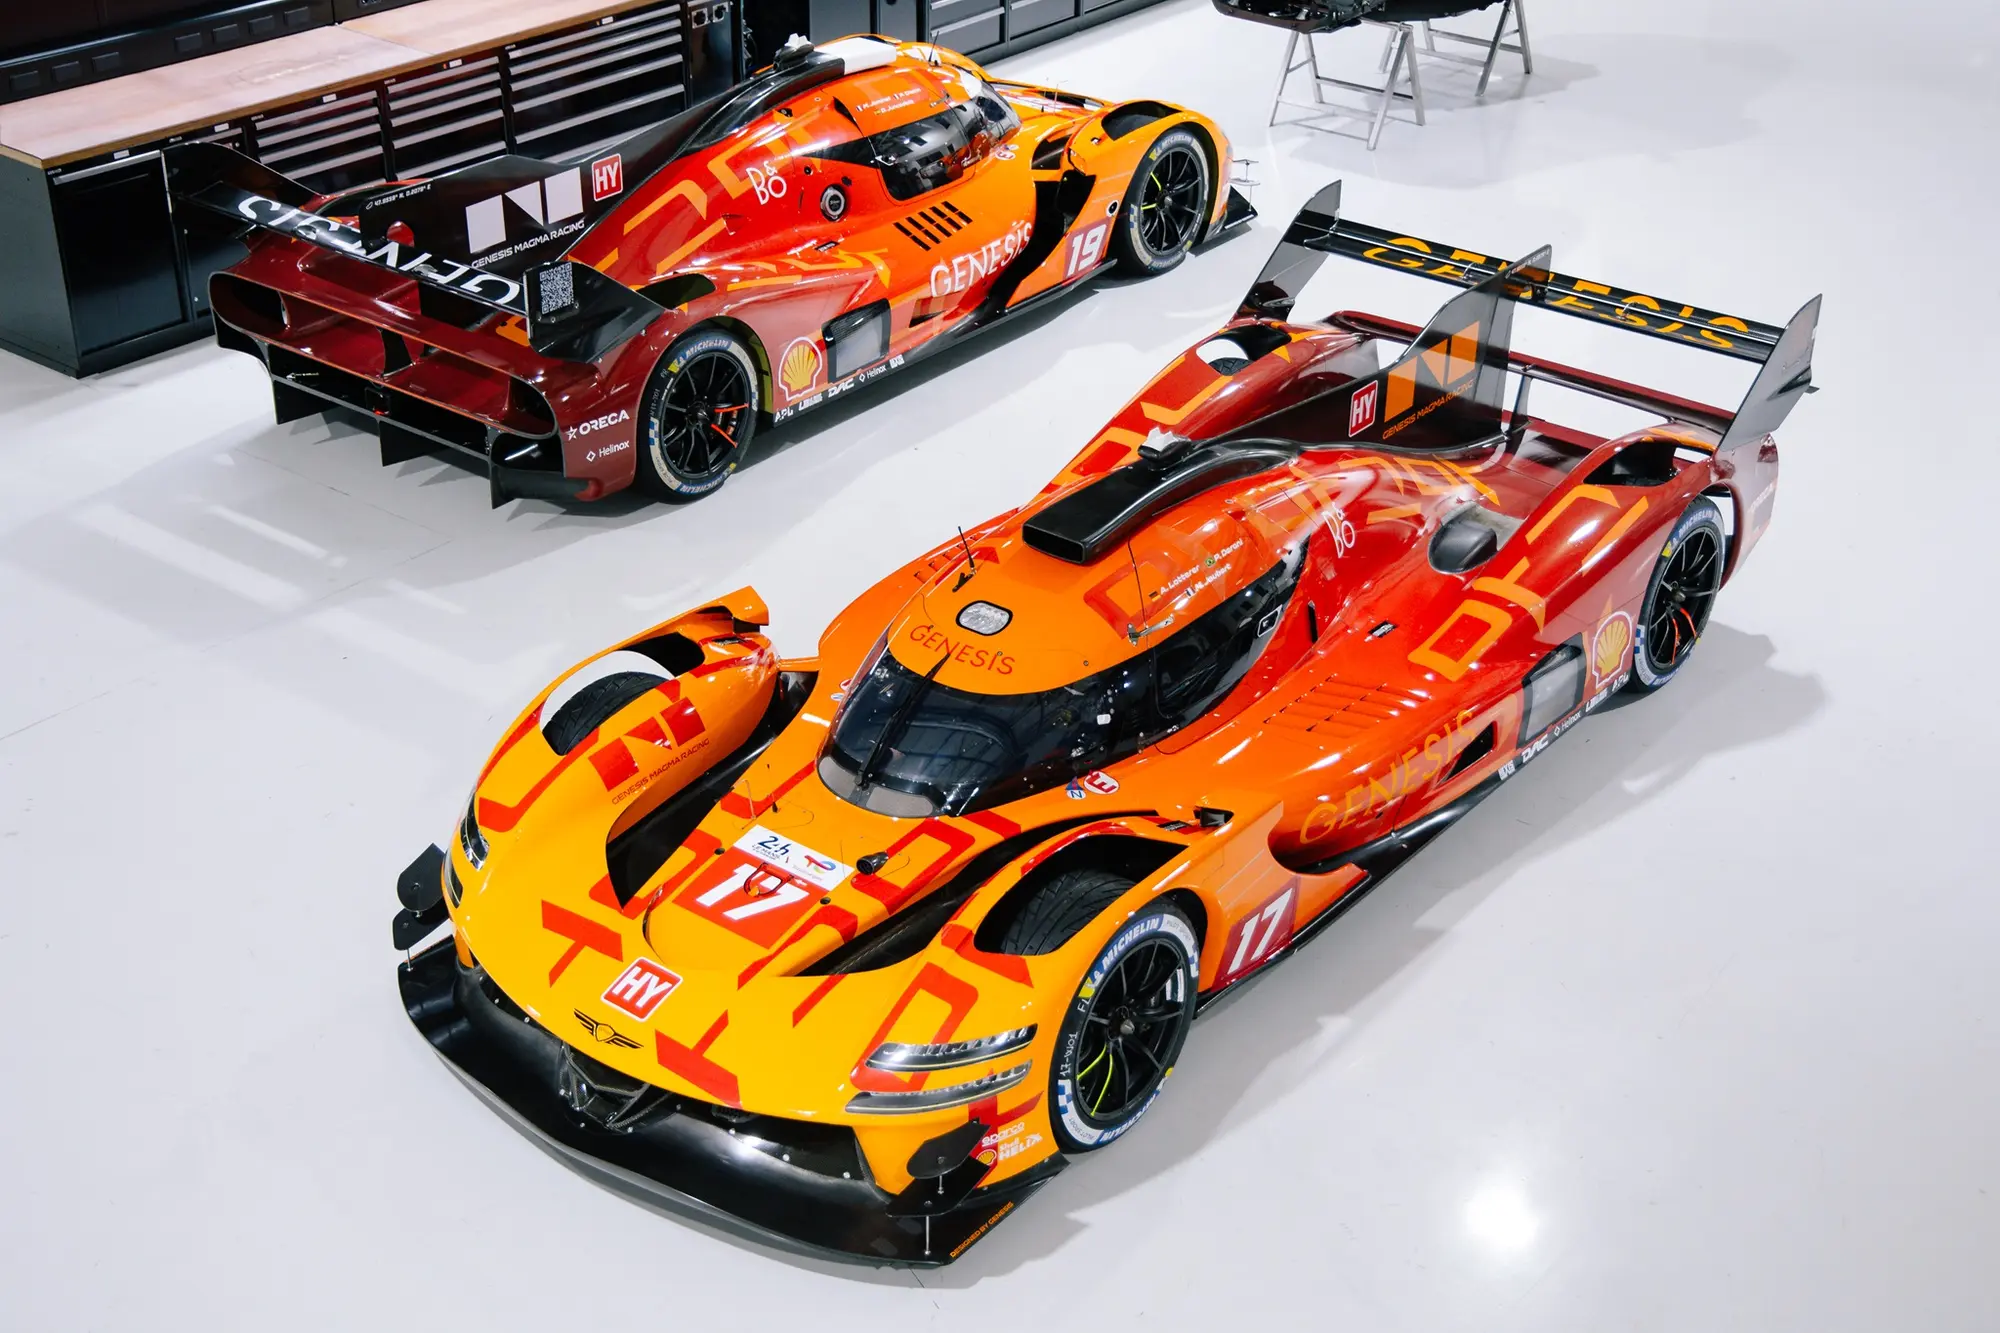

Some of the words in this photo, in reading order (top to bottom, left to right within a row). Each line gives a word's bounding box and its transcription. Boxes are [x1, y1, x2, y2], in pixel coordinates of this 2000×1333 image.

[595, 161, 619, 193] HY
[471, 247, 513, 269] GENESIS
[513, 233, 549, 253] MAGMA
[549, 218, 585, 240] RACING
[931, 222, 1032, 297] GENESIS
[1066, 223, 1107, 277] 19
[685, 339, 729, 359] MICHELIN
[828, 378, 854, 398] DAC
[866, 365, 887, 380] Helinox
[579, 409, 630, 435] ORECA
[1352, 389, 1376, 428] HY
[1382, 413, 1415, 440] GENESIS
[1416, 397, 1446, 419] MAGMA
[1445, 379, 1475, 402] RACING
[599, 440, 630, 457] Helinox
[1168, 565, 1200, 589] Lotterer
[910, 625, 1015, 675] GENESIS
[1561, 711, 1582, 732] Helinox
[1521, 734, 1549, 763] DAC
[611, 775, 649, 805] GENESIS
[649, 757, 682, 780] MAGMA
[681, 738, 710, 760] RACING
[1300, 709, 1475, 844] GENESIS
[696, 863, 810, 920] 17
[1102, 917, 1159, 967] MICHELIN
[1227, 887, 1293, 975] 17
[611, 966, 673, 1009] HY
[1077, 996, 1090, 1013] FL
[982, 1122, 1025, 1147] sparco
[950, 1229, 981, 1258] DESIGNED
[979, 1222, 989, 1234] BY
[988, 1201, 1015, 1225] GENESIS
